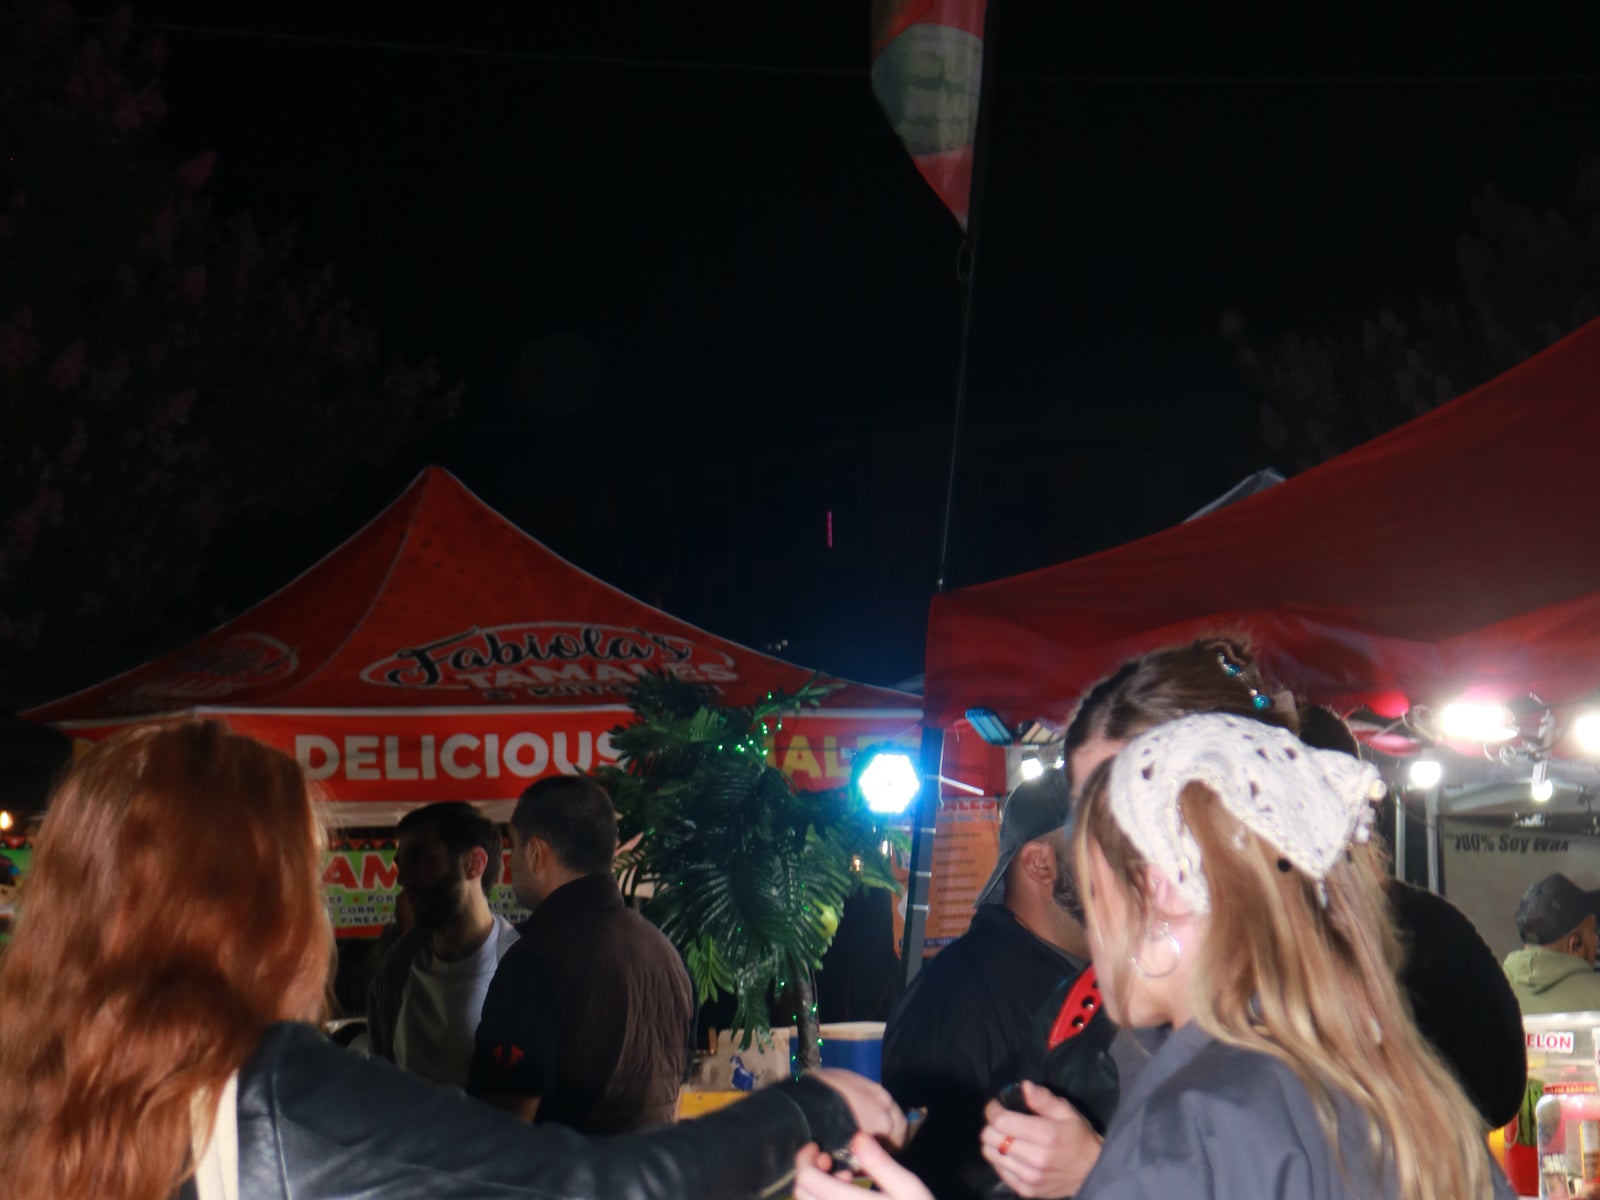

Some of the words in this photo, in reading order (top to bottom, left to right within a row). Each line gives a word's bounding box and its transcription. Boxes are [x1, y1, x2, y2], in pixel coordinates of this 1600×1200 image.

[1498, 832, 1530, 853] Soy
[367, 895, 396, 903] POR
[1527, 1033, 1572, 1049] ELON
